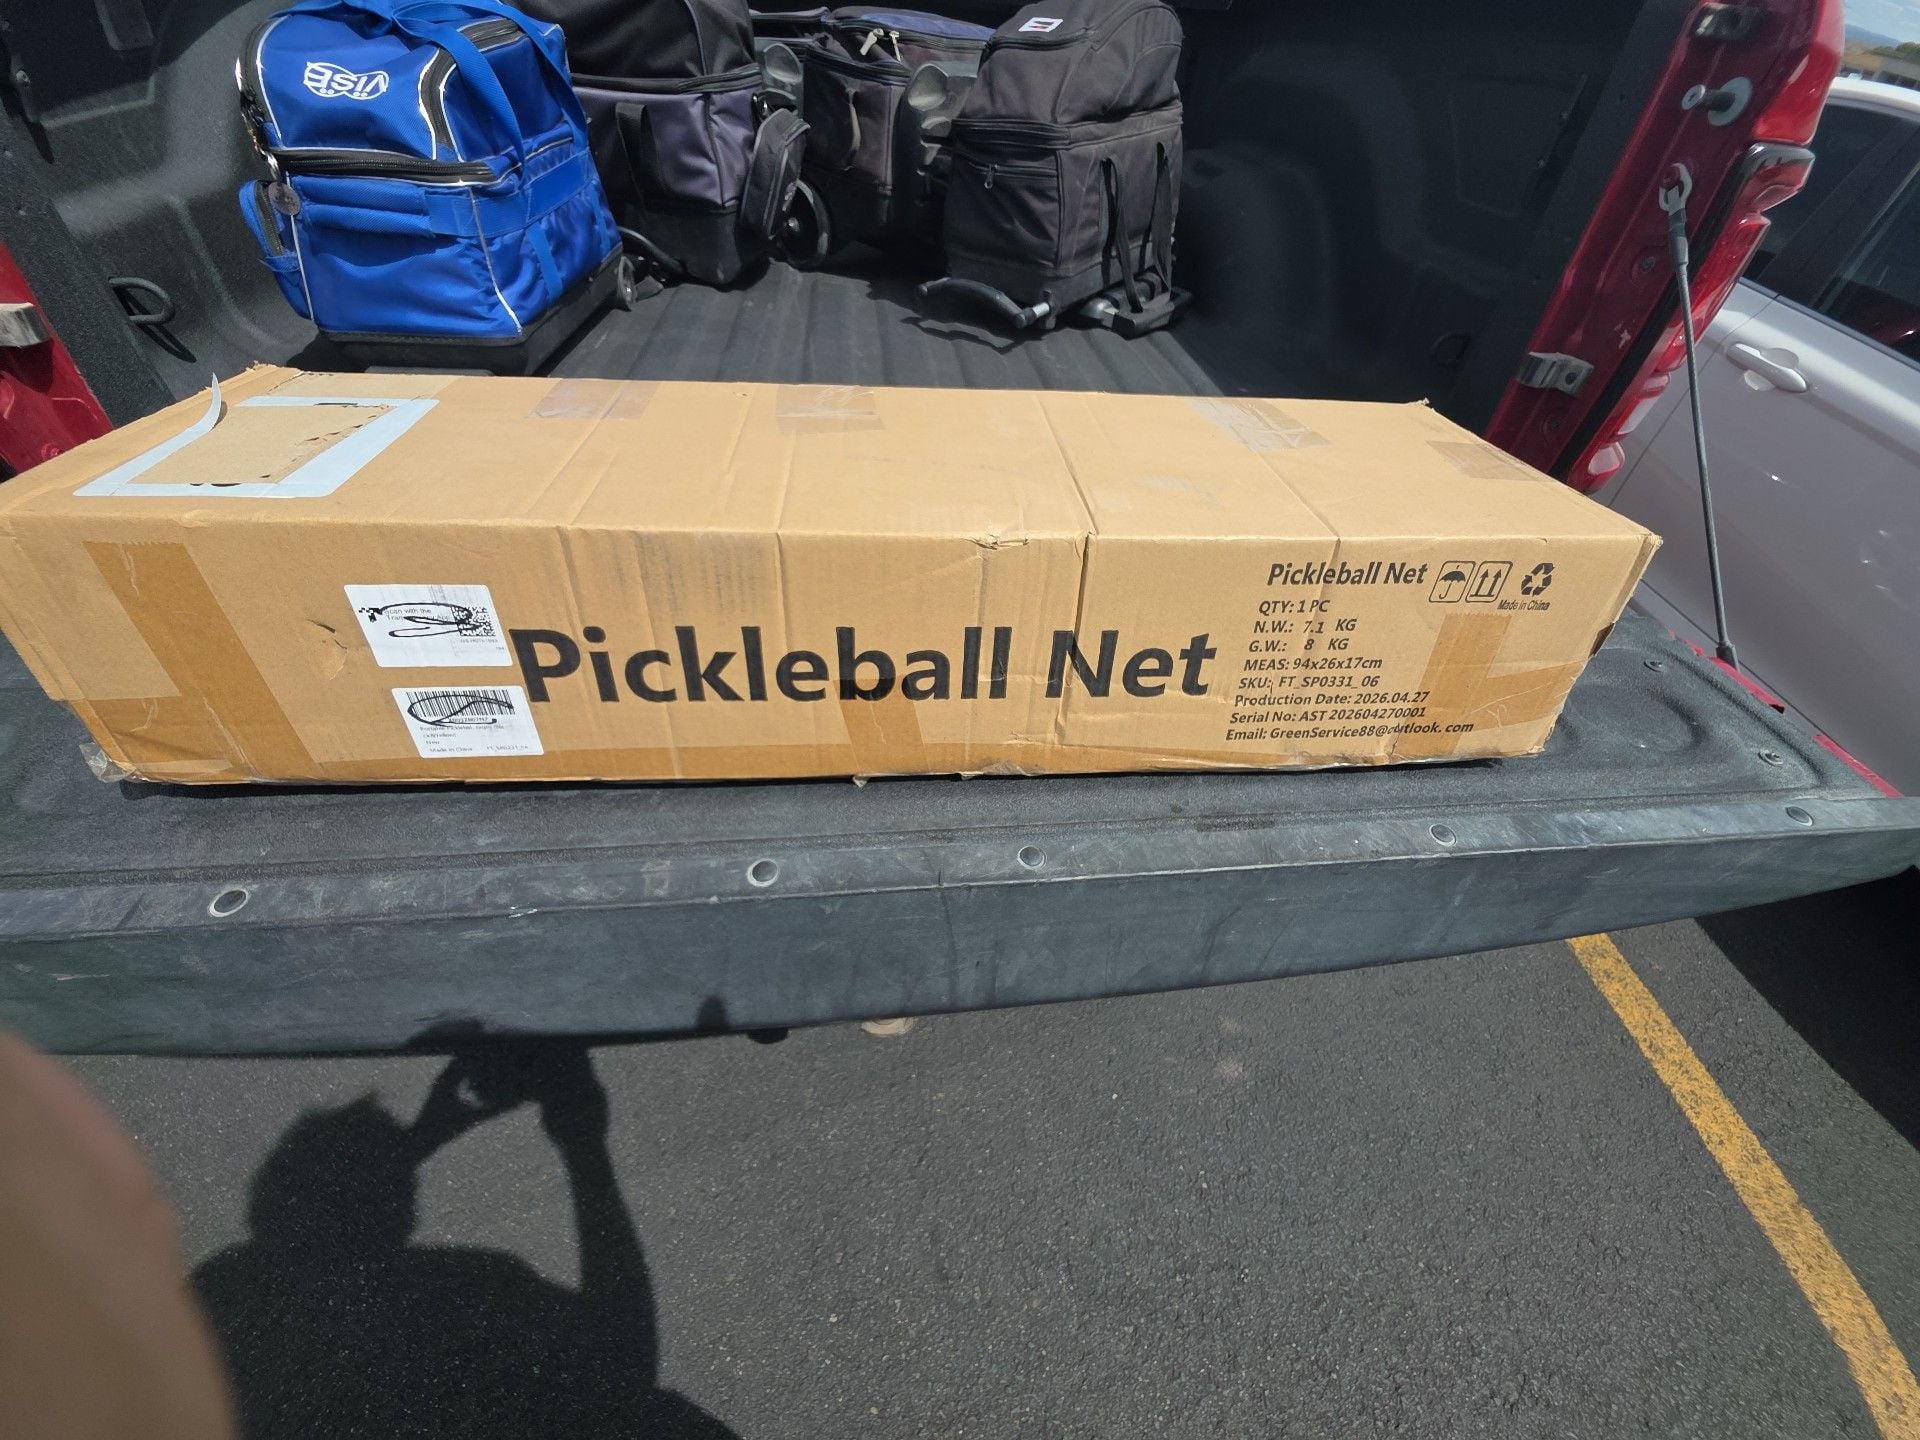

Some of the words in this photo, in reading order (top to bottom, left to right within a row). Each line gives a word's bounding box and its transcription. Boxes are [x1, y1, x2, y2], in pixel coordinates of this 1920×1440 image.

[304, 62, 386, 94] VISE
[1267, 561, 1382, 586] Pickleball
[1383, 562, 1428, 585] Net
[1258, 600, 1295, 616] QTY:
[1296, 600, 1305, 613] 1
[1309, 600, 1331, 613] PC
[1497, 599, 1518, 611] Made
[1527, 599, 1551, 611] China
[1253, 620, 1294, 633] N.W.:
[1303, 620, 1325, 634] 7.1
[1335, 619, 1357, 632] KG
[1248, 640, 1287, 653] G.W.:
[1303, 638, 1315, 651] 8
[1327, 638, 1349, 651] KG
[509, 625, 1012, 702] Pickleball
[1045, 629, 1217, 699] Net
[1243, 659, 1290, 672] MEAS:
[1292, 657, 1383, 671] 94x26x17cm
[1238, 677, 1271, 690] SKU:
[1234, 693, 1311, 707] Production
[1315, 693, 1352, 705] Date:
[1353, 691, 1430, 705] 2026.04.27
[1229, 711, 1270, 725] Serial
[1272, 711, 1297, 723] No:
[1299, 710, 1328, 722] AST
[1329, 706, 1426, 720] 202604270001
[1225, 728, 1267, 741] Email:
